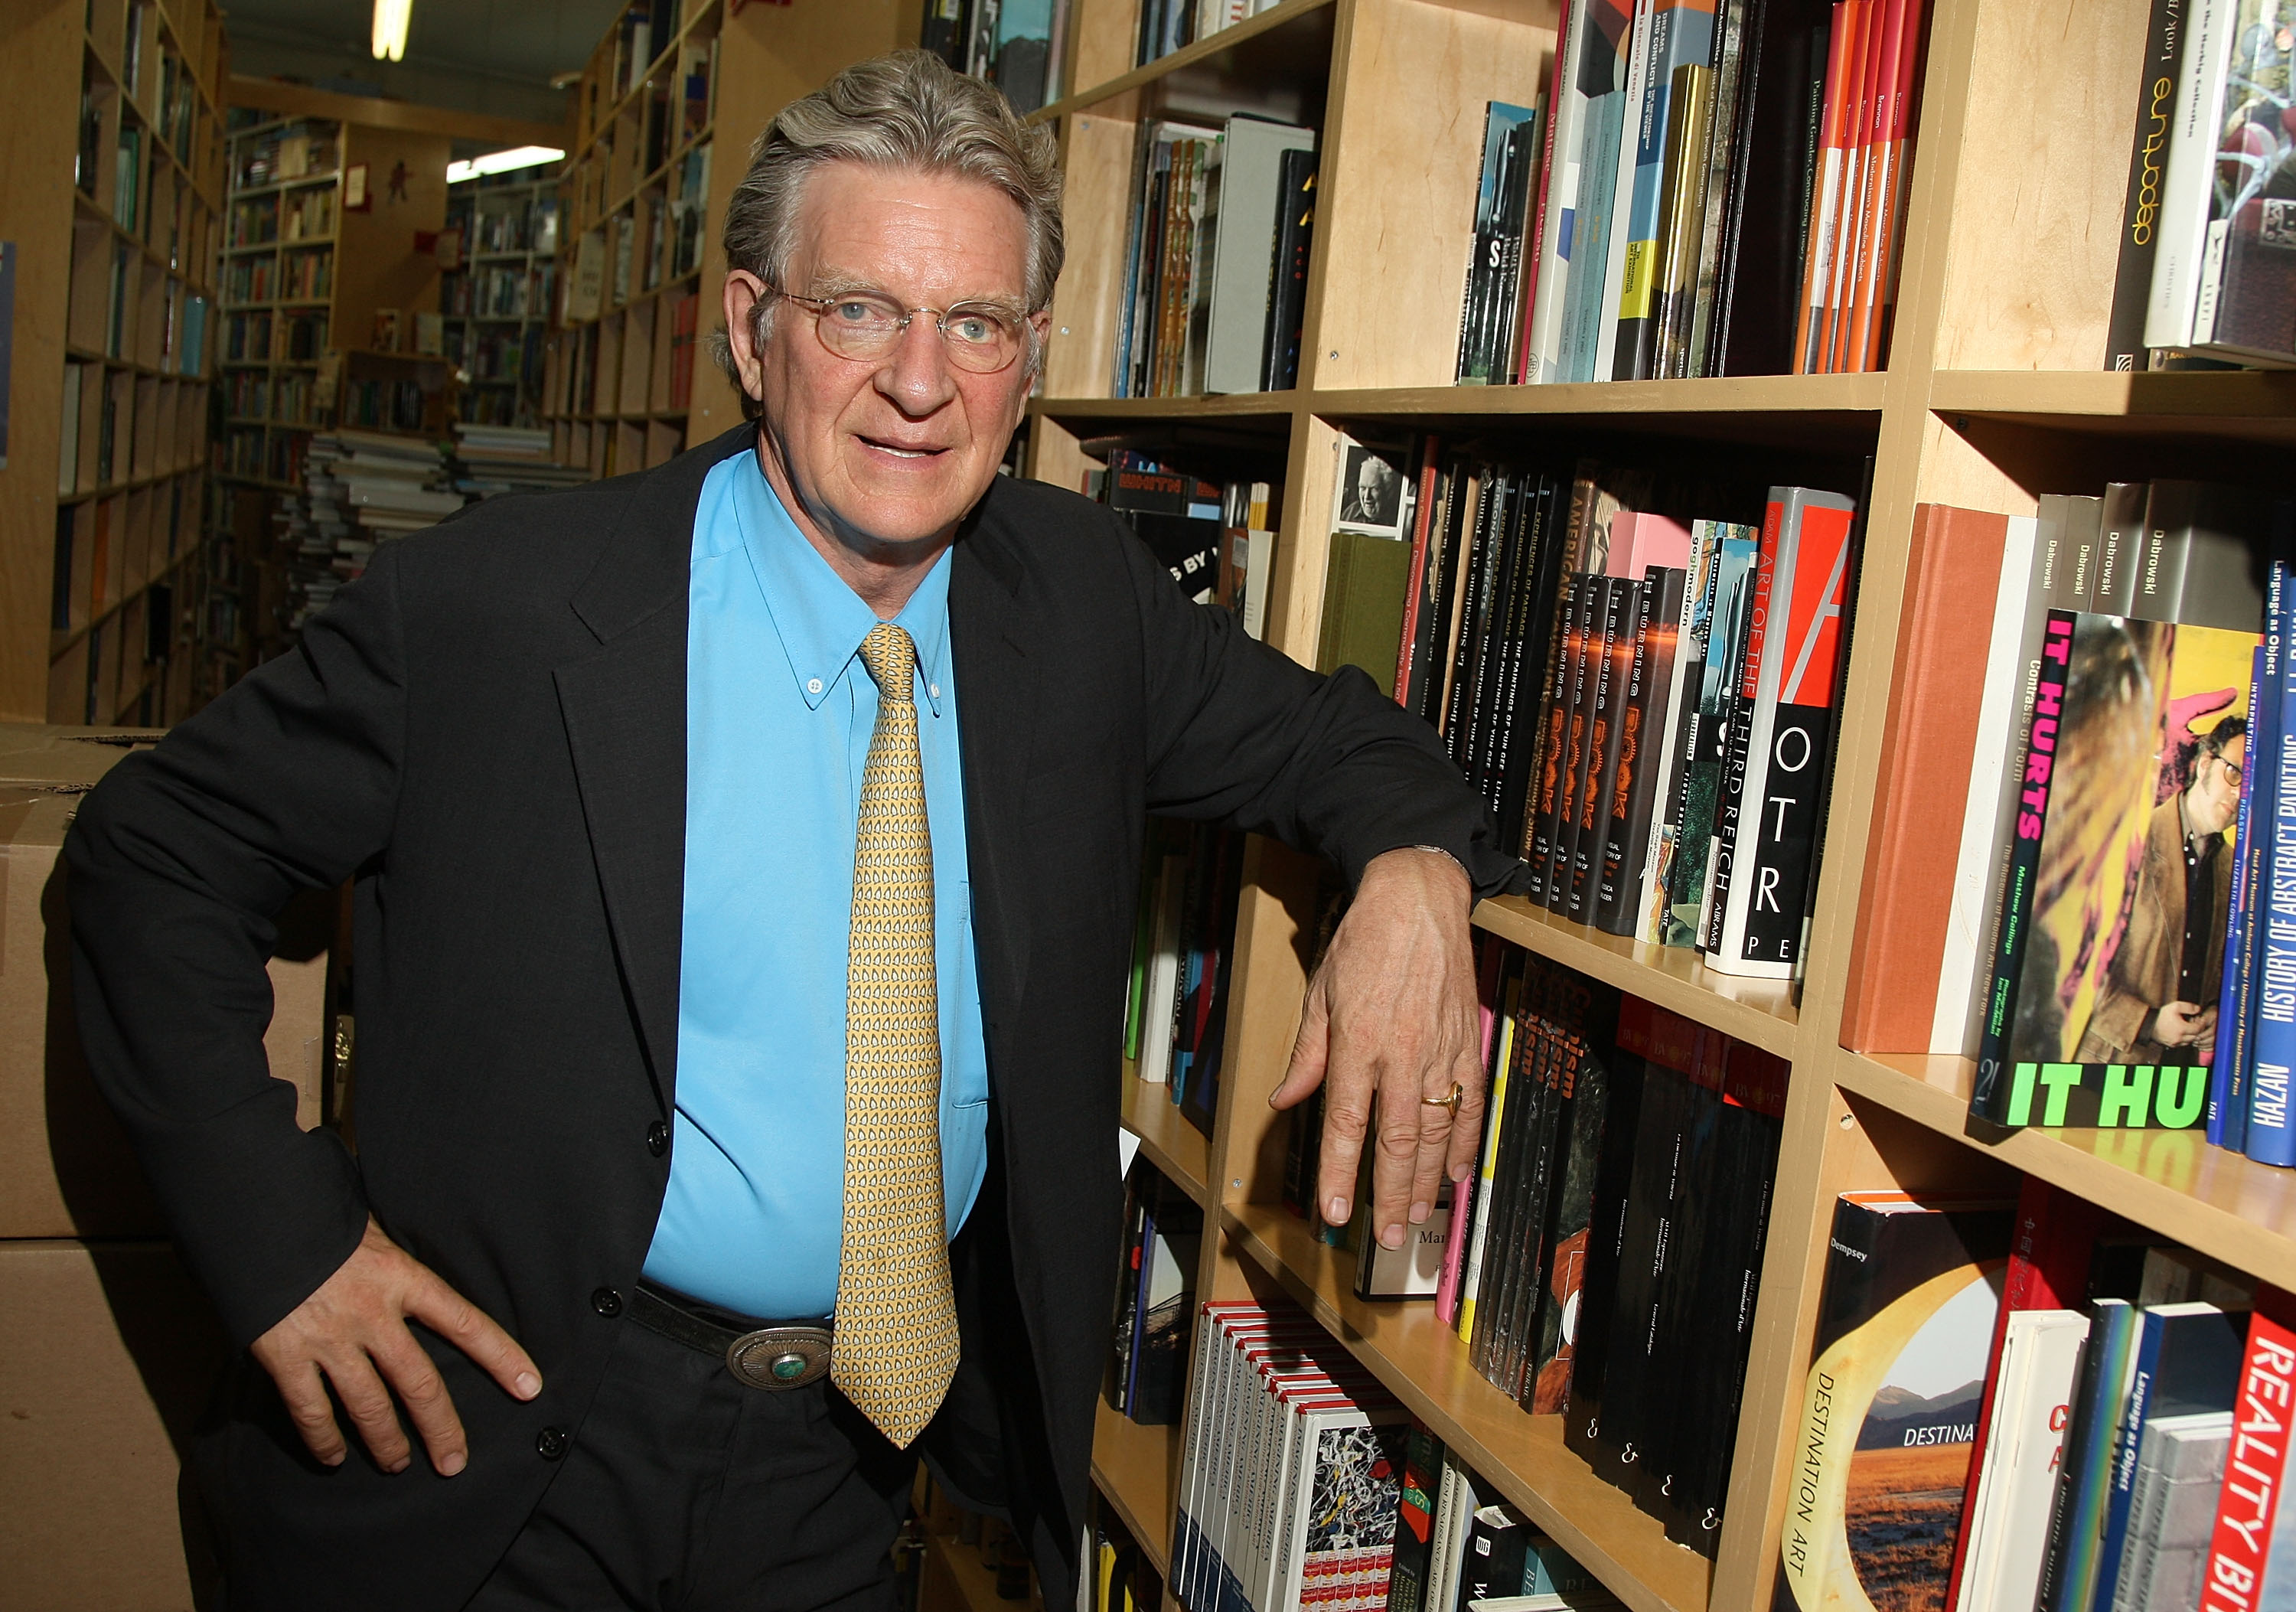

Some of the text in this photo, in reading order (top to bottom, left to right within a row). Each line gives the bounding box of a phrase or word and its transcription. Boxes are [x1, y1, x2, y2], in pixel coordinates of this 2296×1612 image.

[1634, 27, 1643, 60] Biennale
[1648, 14, 1662, 88] AND CONFLICTS
[1658, 11, 1668, 53] DREAMS
[1809, 80, 1821, 123] Painting
[1875, 95, 1884, 129] Brennan
[1893, 92, 1902, 126] Brennan
[1806, 126, 1817, 167] Gender,
[2131, 77, 2172, 246] departure
[1801, 168, 1813, 226] Constructing
[1857, 155, 1877, 282] Modernism's Masculine Subjects
[1875, 152, 1895, 281] Modernism's Masculine Subjects
[1623, 257, 1634, 294] EXHIBITION
[1626, 243, 1640, 292] INTERNATIONAL
[1479, 478, 1503, 609] PERSONAL AFFECTS
[1493, 509, 1507, 571] EXPERIENCES
[1527, 511, 1541, 576] EXPERIENCES
[1763, 509, 1776, 543] ADAM
[1183, 550, 1206, 575] BY
[1491, 575, 1498, 586] OF
[1524, 579, 1531, 592] OF
[1680, 537, 1701, 627] goghmodern
[1754, 553, 1774, 601] ART
[2042, 539, 2057, 589] Dabrowski
[2073, 544, 2090, 595] Dabrowski
[2099, 530, 2119, 596] Dabrowski
[2144, 529, 2164, 595] Dabrowski
[1444, 481, 1488, 758] ndré Breton Le Surréalisme et la Peinture
[1485, 589, 1495, 631] PASSAGE
[1518, 595, 1529, 637] PASSAGE
[1750, 606, 1766, 640] OF
[2264, 560, 2284, 675] Language as Object
[1481, 634, 1489, 652] THE
[1514, 640, 1523, 658] THE
[1554, 608, 1573, 698] BURNING
[1574, 612, 1591, 704] BURNING
[1596, 615, 1616, 709] BURNING
[1629, 600, 1650, 697] BURNING
[1474, 654, 1486, 703] PAINTINGS
[1506, 661, 1519, 711] PAINTINGS
[1741, 646, 1761, 695] THE
[1472, 706, 1479, 719] OF
[1504, 714, 1511, 727] OF
[2013, 658, 2040, 783] Contrasts of Form
[2015, 618, 2073, 841] IT HURTS
[2245, 682, 2257, 752] INTERPRETING
[1497, 752, 1505, 770] GEE
[1687, 718, 1697, 757] SURREALISM
[1727, 705, 1753, 794] THIRD
[1776, 727, 1811, 772] O
[1491, 780, 1502, 812] LI-LAN
[1673, 772, 1689, 848] FIONA BRADLEY
[1769, 797, 1795, 841] T
[1713, 808, 1739, 890] REICH
[2252, 848, 2261, 867] Mead
[2271, 822, 2296, 916] ABSTRACT
[1756, 867, 1780, 912] R
[2227, 859, 2241, 938] ELIZABETH COWLING
[2248, 883, 2258, 912] Museum
[2251, 868, 2259, 881] Art
[1661, 909, 1670, 926] TATE
[1707, 902, 1723, 947] ABRAMS
[1978, 843, 2012, 1017] The Museum of Modern Art, New York
[2004, 865, 2025, 955] Matthew Collings
[2268, 918, 2296, 941] OF
[2244, 922, 2254, 951] Amherst
[2241, 952, 2251, 978] College
[2262, 945, 2295, 1023] HISTORY
[1990, 991, 2001, 1034] MacMillan
[1994, 977, 2009, 1037] Photographs by
[2237, 983, 2249, 1017] University
[2232, 1028, 2244, 1076] Massachusetts
[2007, 1062, 2208, 1130] IT HU
[2208, 1101, 2216, 1120] TATE
[2230, 1077, 2239, 1096] Press
[2252, 1062, 2290, 1129] HAZAN
[1829, 1236, 1868, 1263] Dempsey
[2115, 1370, 2150, 1491] Language as Object
[1786, 1372, 1835, 1577] DESTINATION ART
[2210, 1333, 2295, 1612] REALITY BI
[1430, 1568, 1439, 1587] ART
[2042, 1548, 2056, 1598] WALLPAPER
[1429, 1591, 1436, 1604] OF
